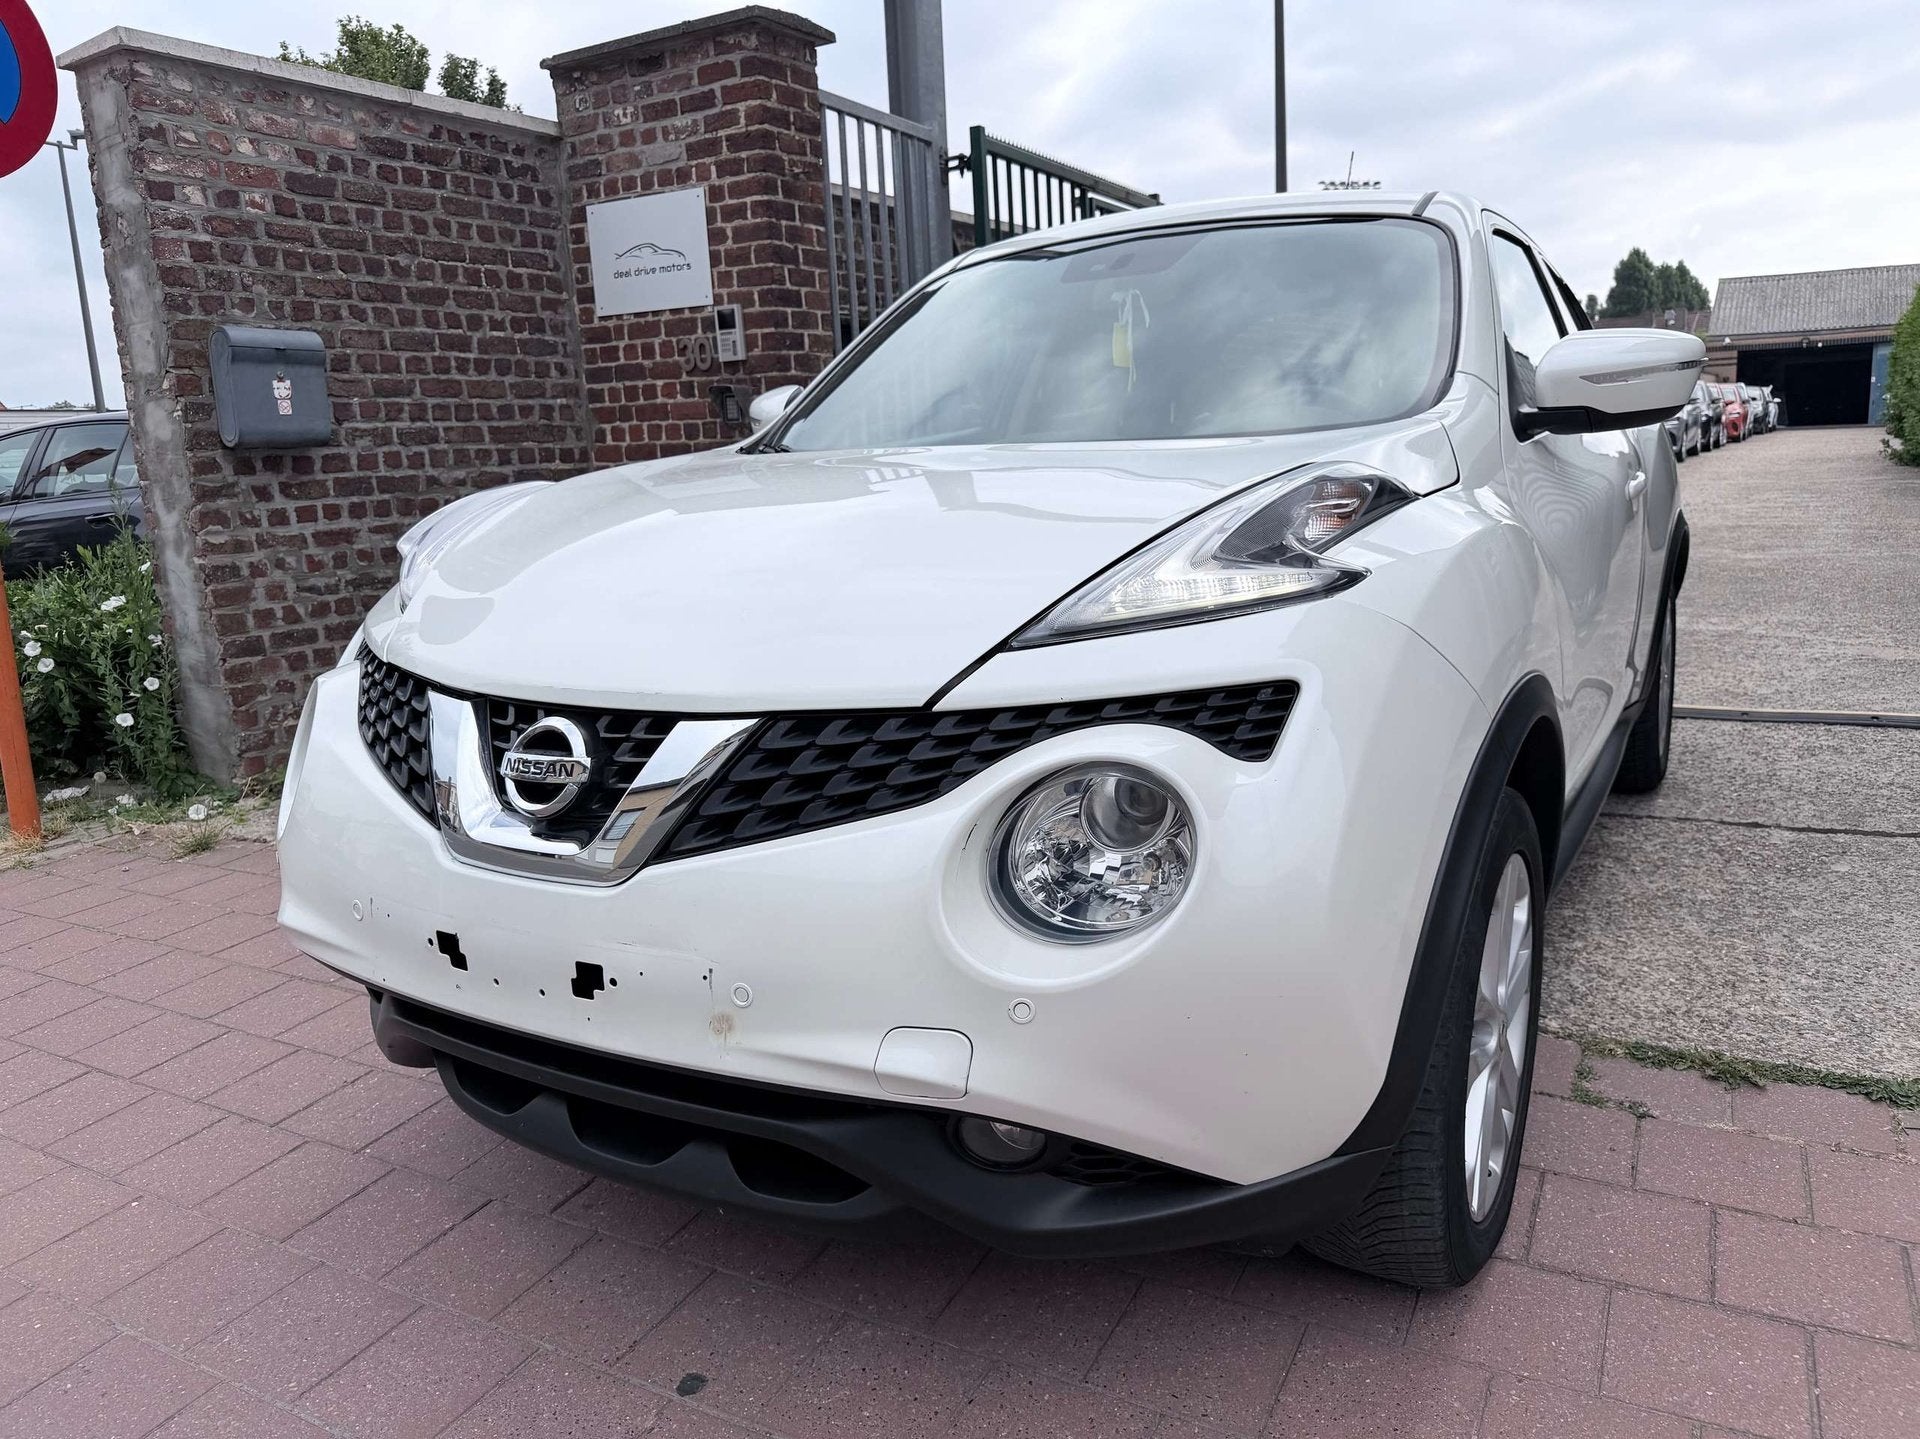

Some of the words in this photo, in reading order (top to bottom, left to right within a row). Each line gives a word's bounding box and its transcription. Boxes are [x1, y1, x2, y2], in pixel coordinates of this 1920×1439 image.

[613, 268, 632, 279] deal
[634, 266, 657, 276] drive
[659, 263, 691, 273] motors
[679, 338, 712, 372] 30
[504, 758, 575, 778] NISSAN
